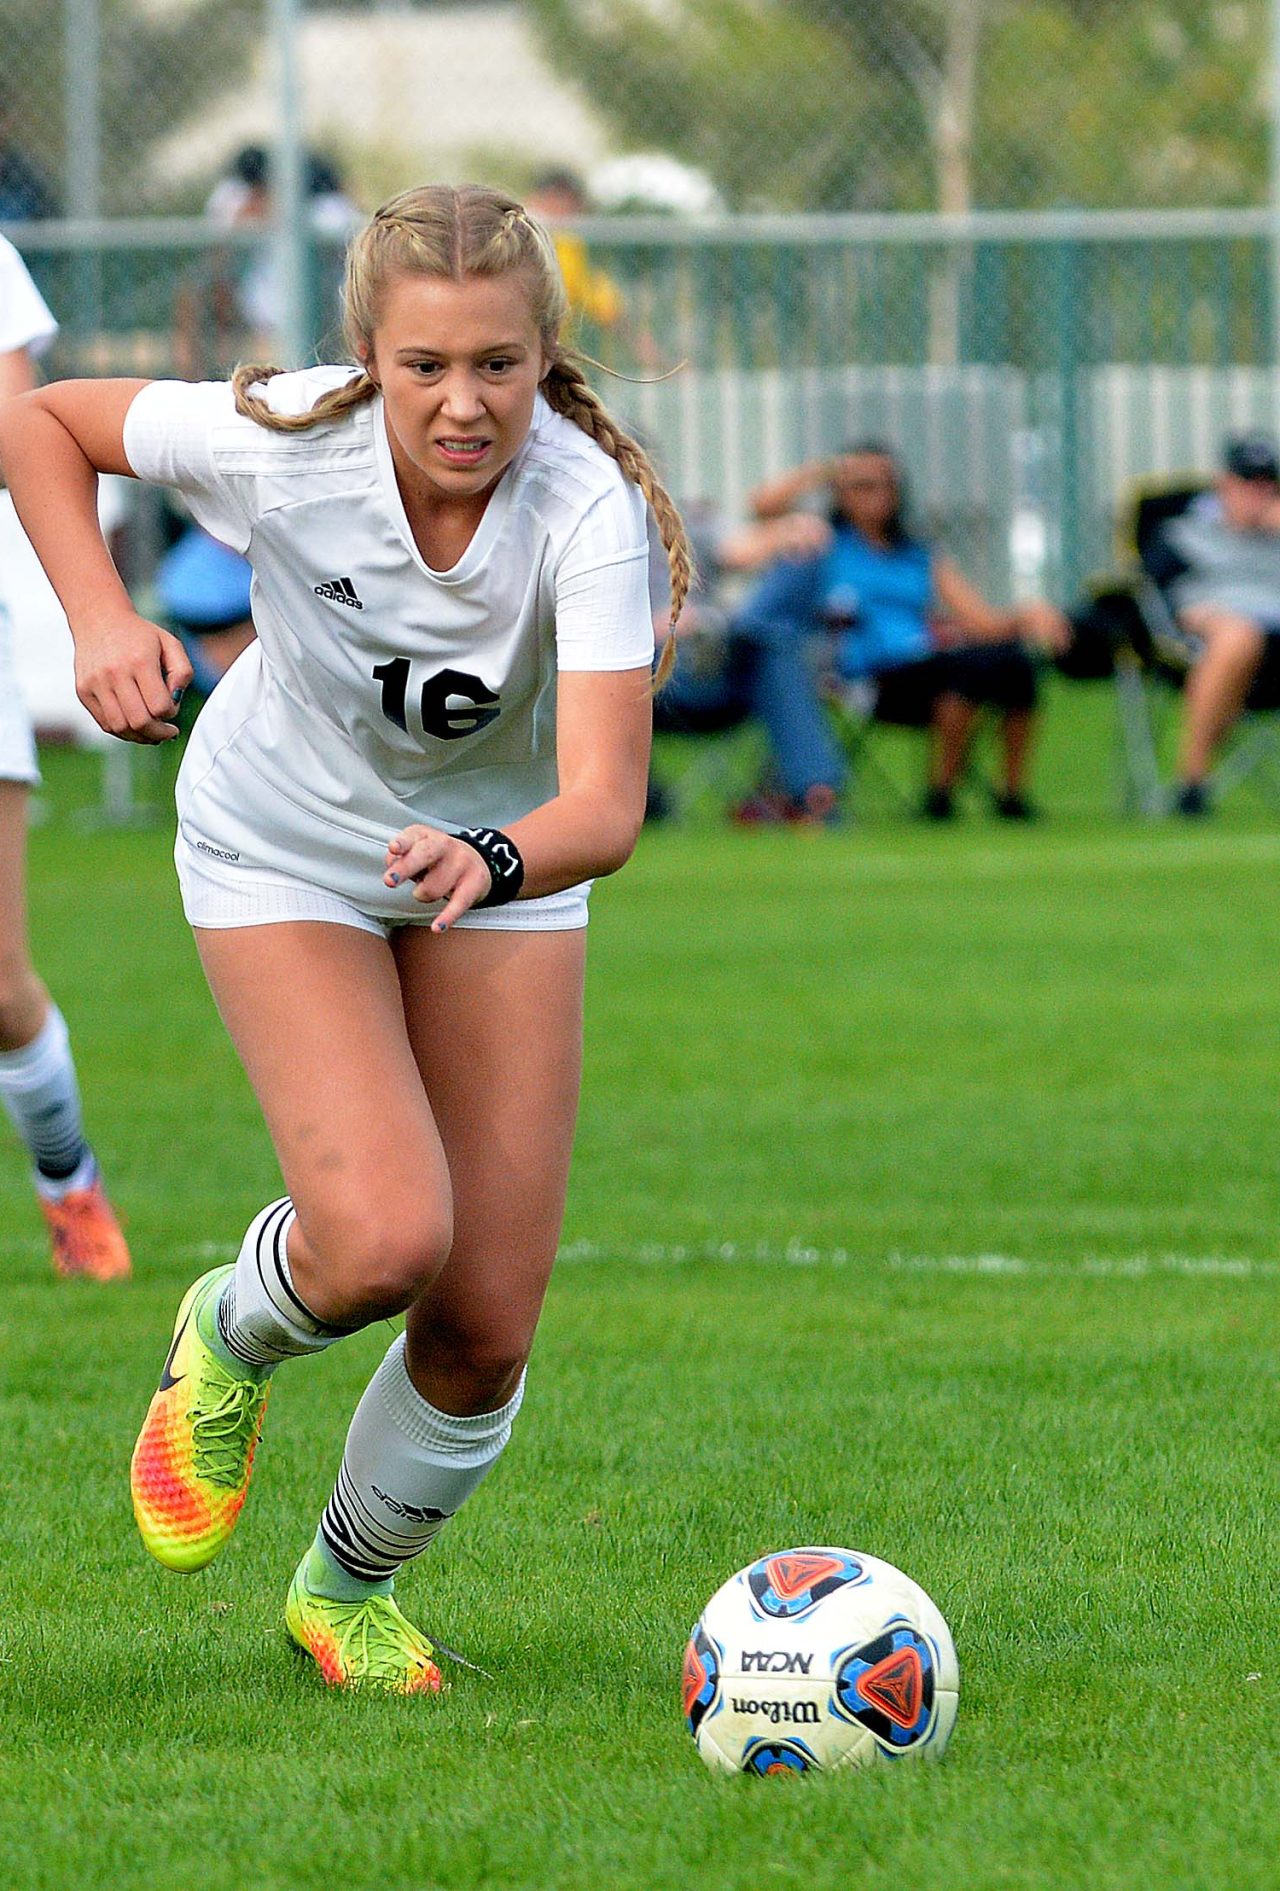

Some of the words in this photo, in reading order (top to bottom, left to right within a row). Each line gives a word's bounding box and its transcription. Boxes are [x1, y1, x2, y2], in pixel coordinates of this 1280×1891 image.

[313, 584, 365, 611] adidas
[371, 656, 501, 741] 16
[196, 841, 240, 861] climacool
[740, 1650, 814, 1675] NCAA
[731, 1696, 822, 1724] Wilson
